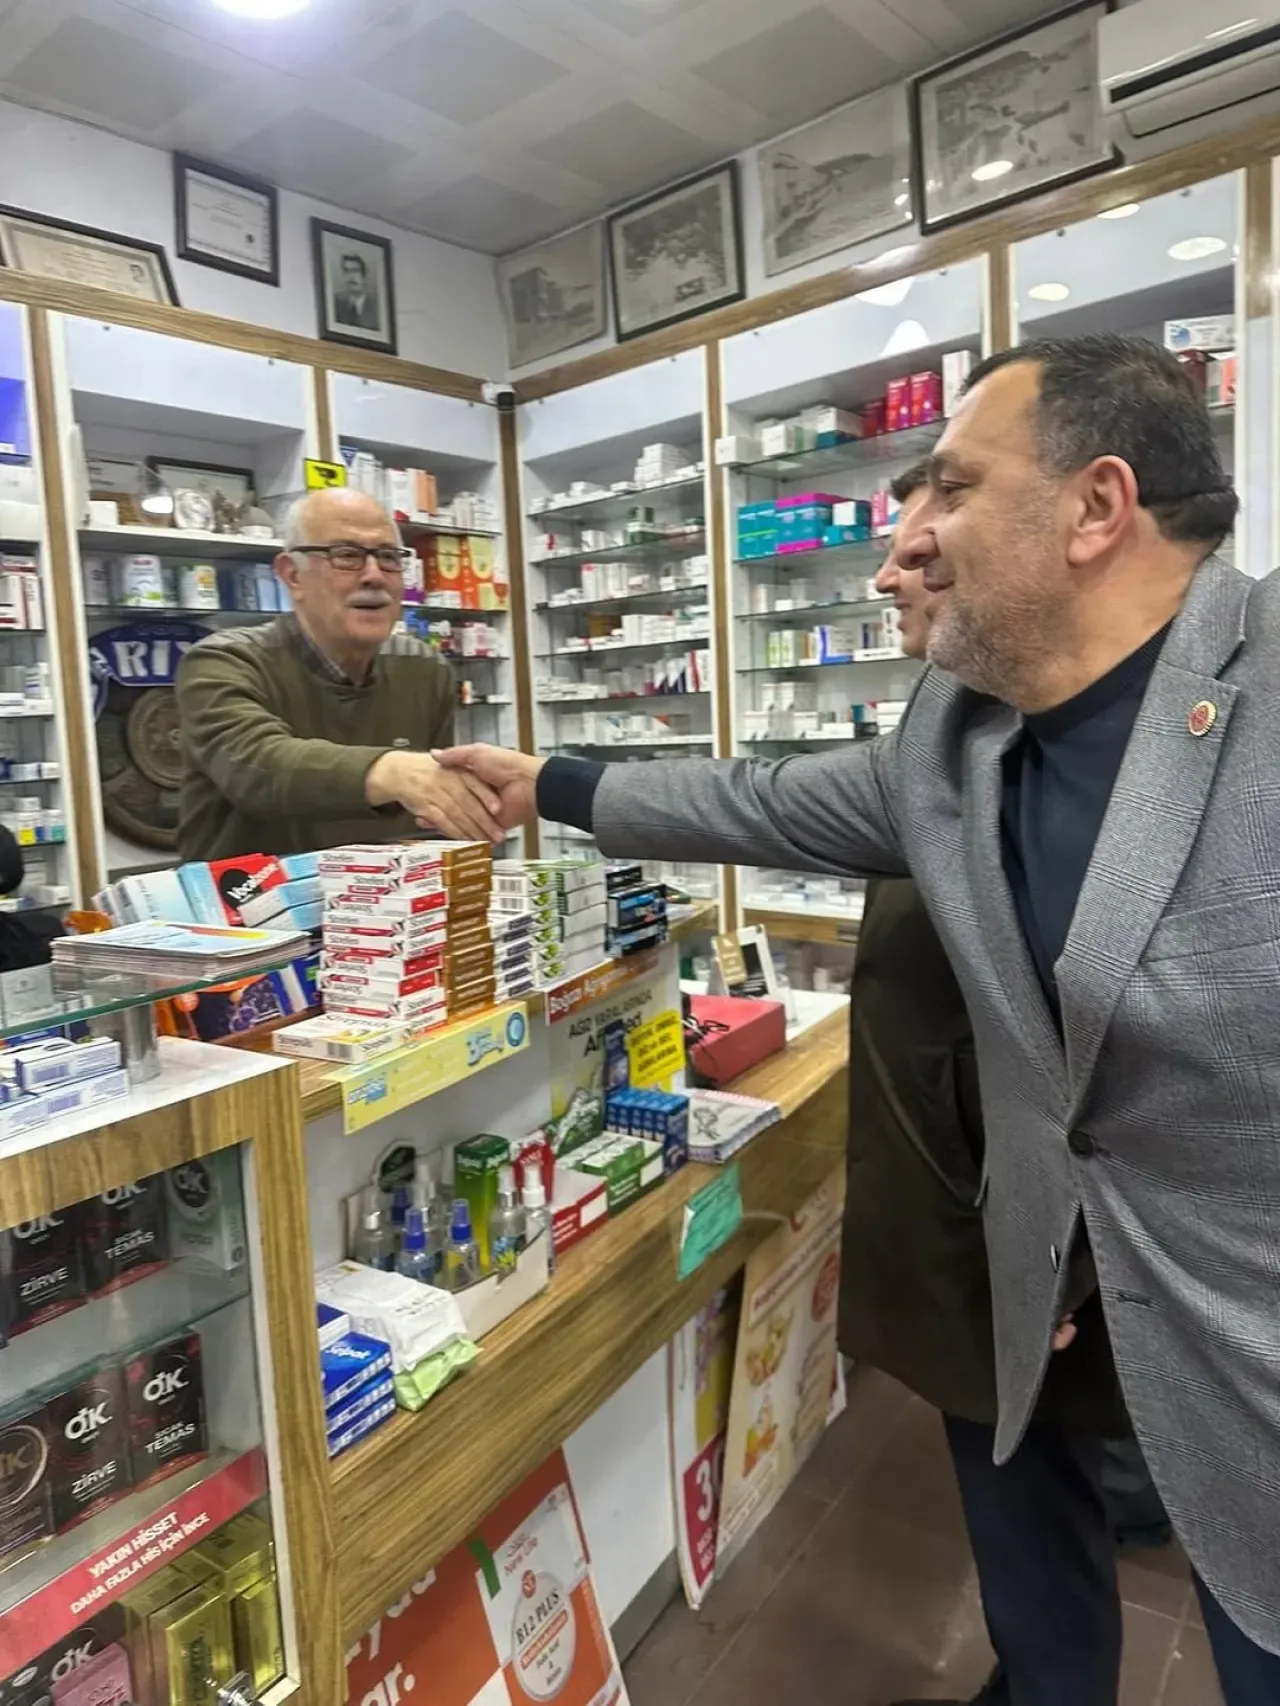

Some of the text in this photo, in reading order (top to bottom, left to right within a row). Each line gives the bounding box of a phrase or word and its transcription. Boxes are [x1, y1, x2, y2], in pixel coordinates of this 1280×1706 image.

[104, 1231, 155, 1260] TEMAS
[143, 1367, 189, 1401] OK
[65, 1403, 113, 1440] OK
[131, 1512, 178, 1550] HİSSET
